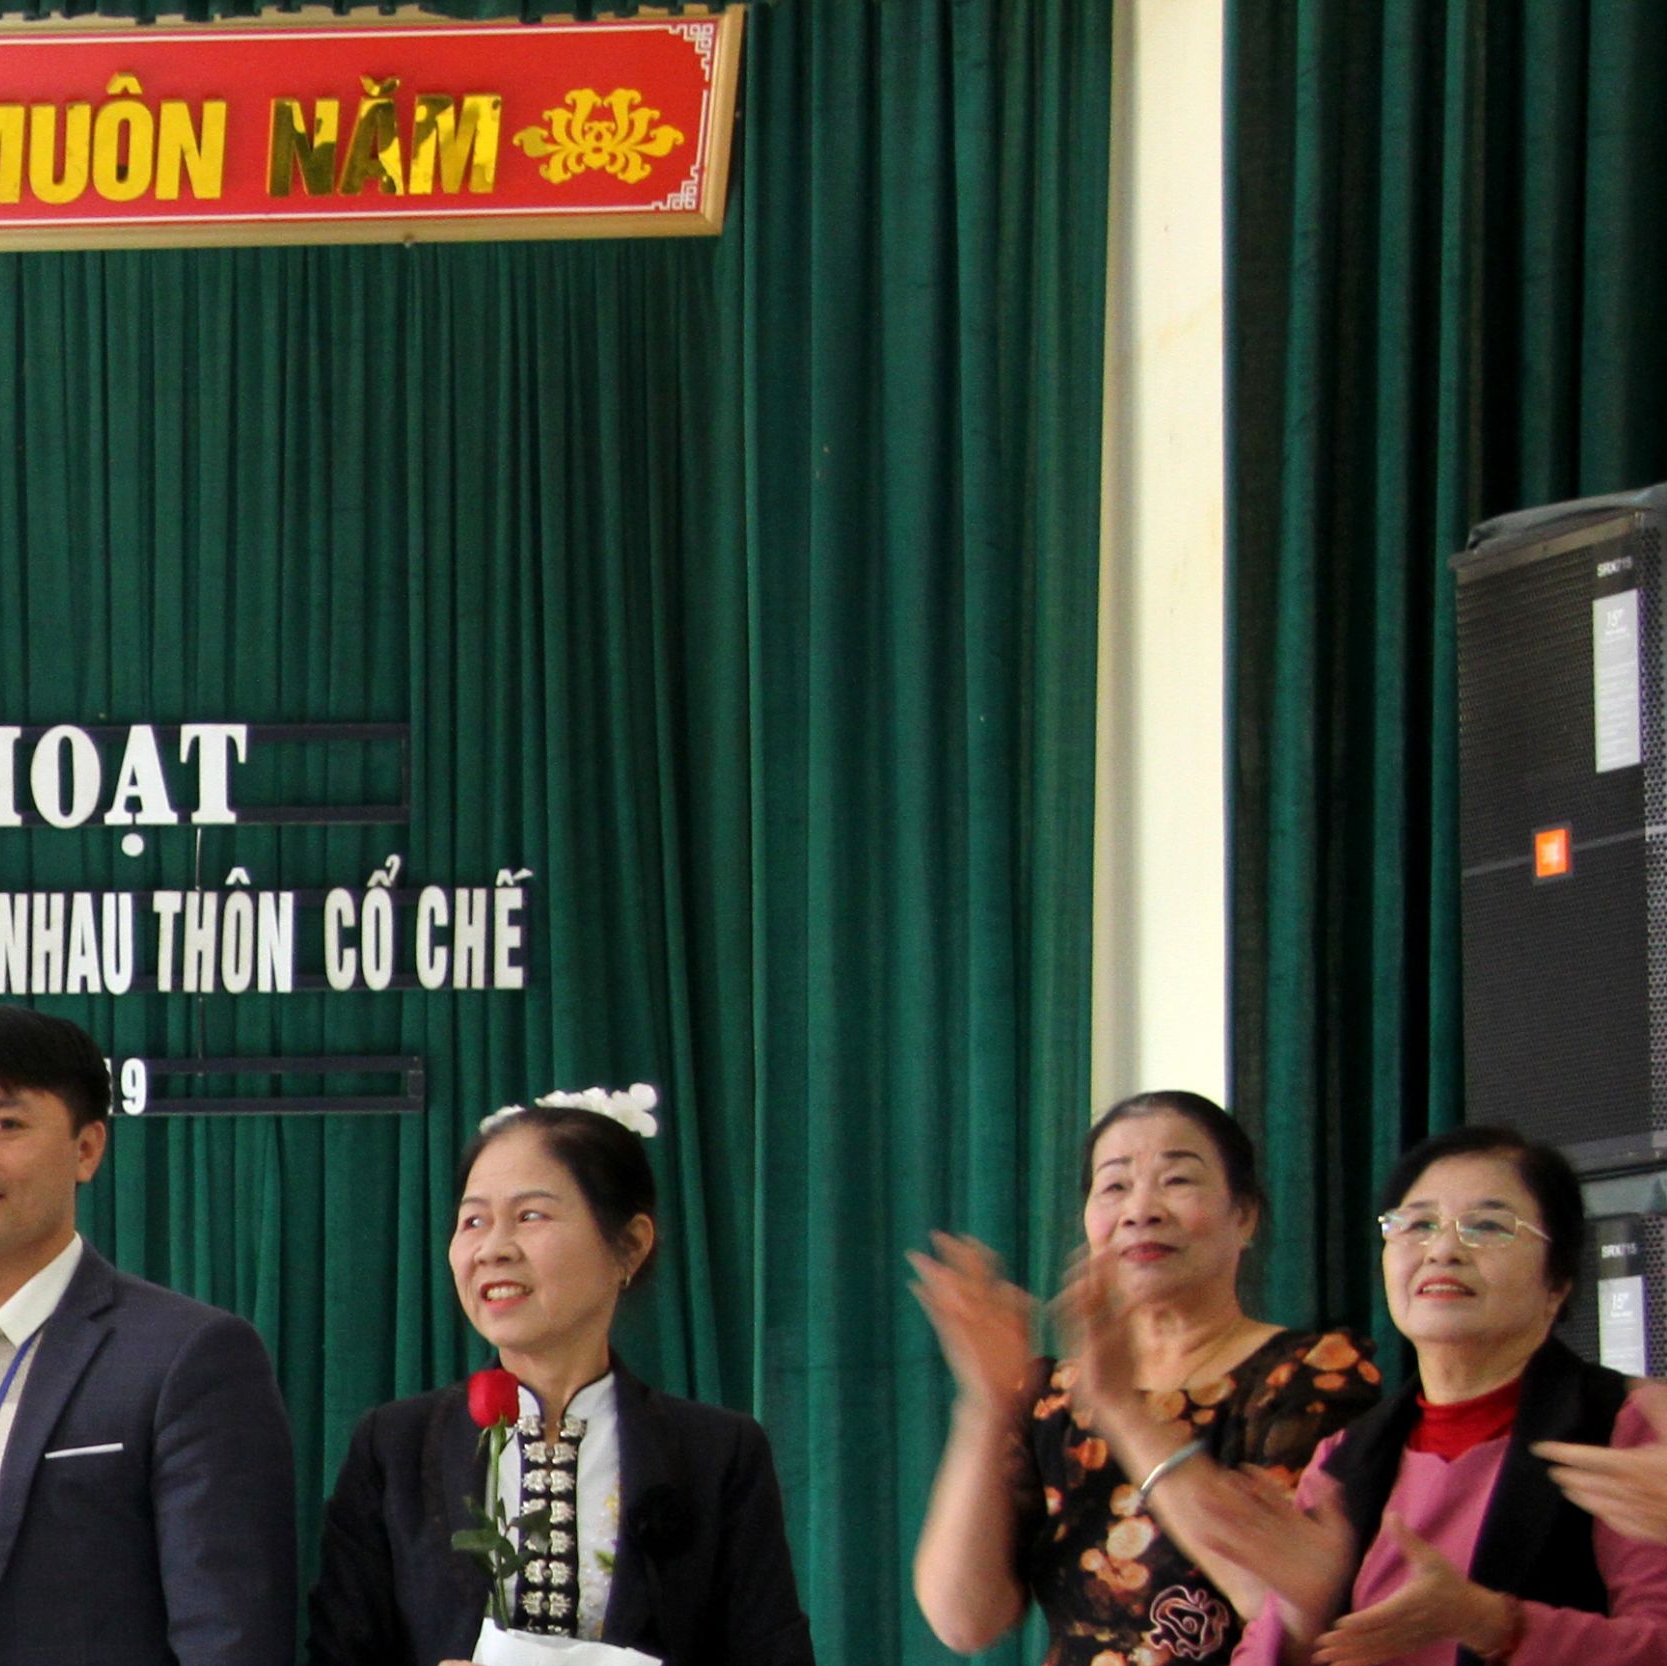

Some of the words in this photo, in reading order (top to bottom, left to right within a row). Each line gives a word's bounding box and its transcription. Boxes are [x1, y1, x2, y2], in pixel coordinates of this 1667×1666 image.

[267, 74, 502, 197] NĂM
[154, 866, 295, 993] THÔN
[324, 854, 402, 991] CỔ
[415, 867, 533, 990] CHẾ
